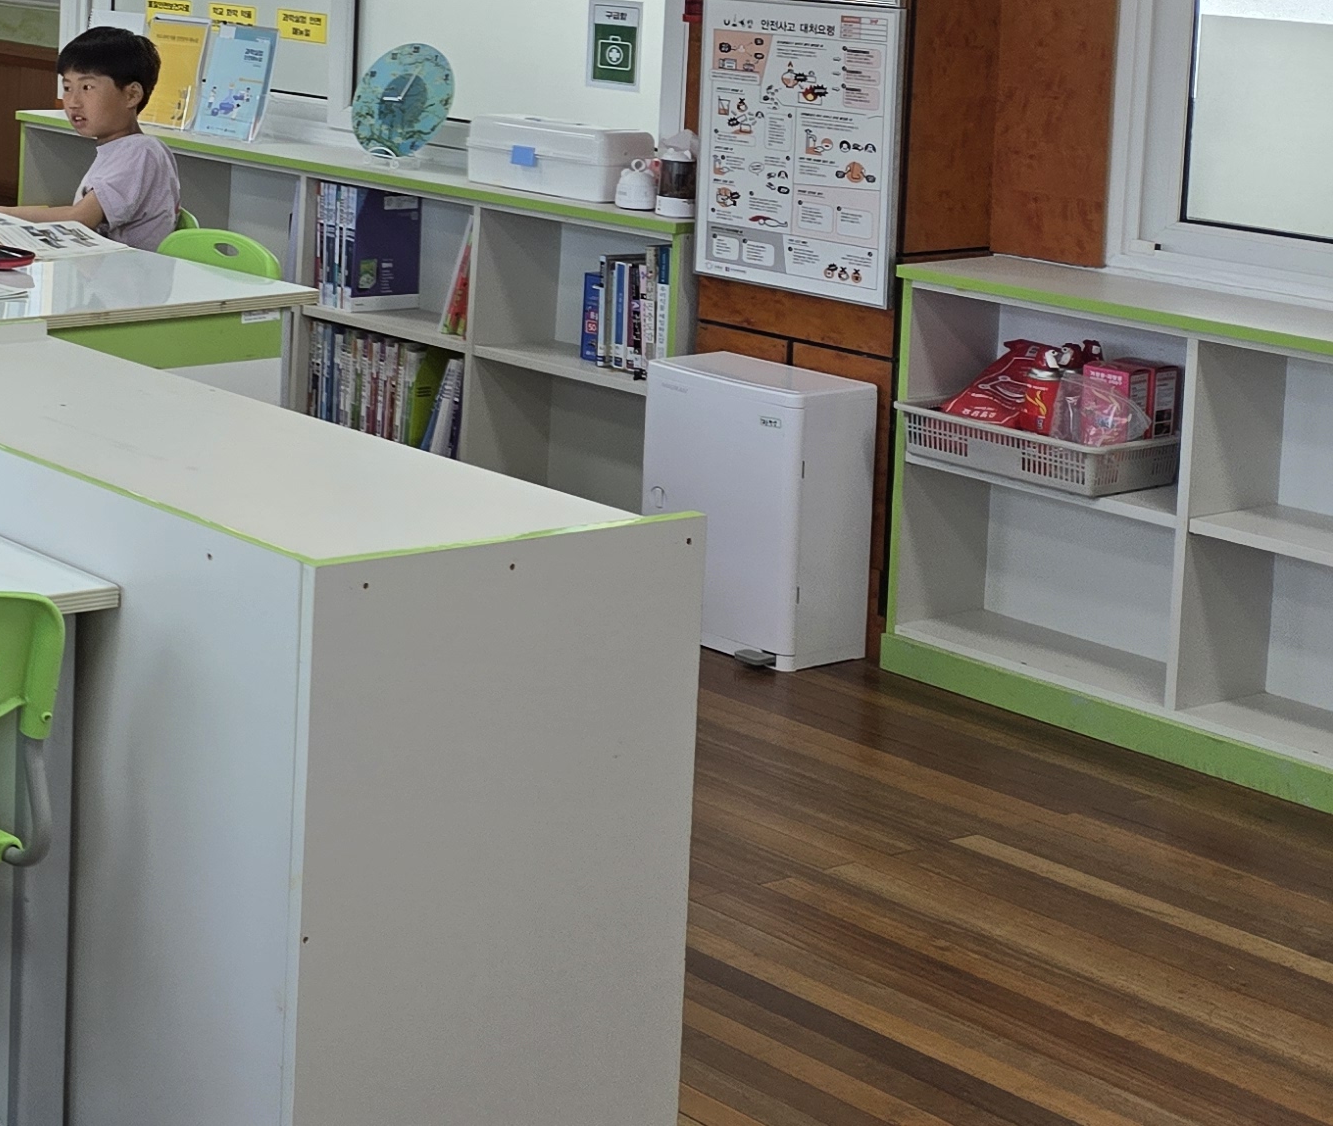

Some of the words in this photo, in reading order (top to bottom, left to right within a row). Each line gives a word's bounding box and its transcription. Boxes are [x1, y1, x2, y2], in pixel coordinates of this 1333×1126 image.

[605, 11, 627, 21] 구급함
[761, 19, 796, 32] 안전사고
[799, 23, 835, 37] 대처요령
